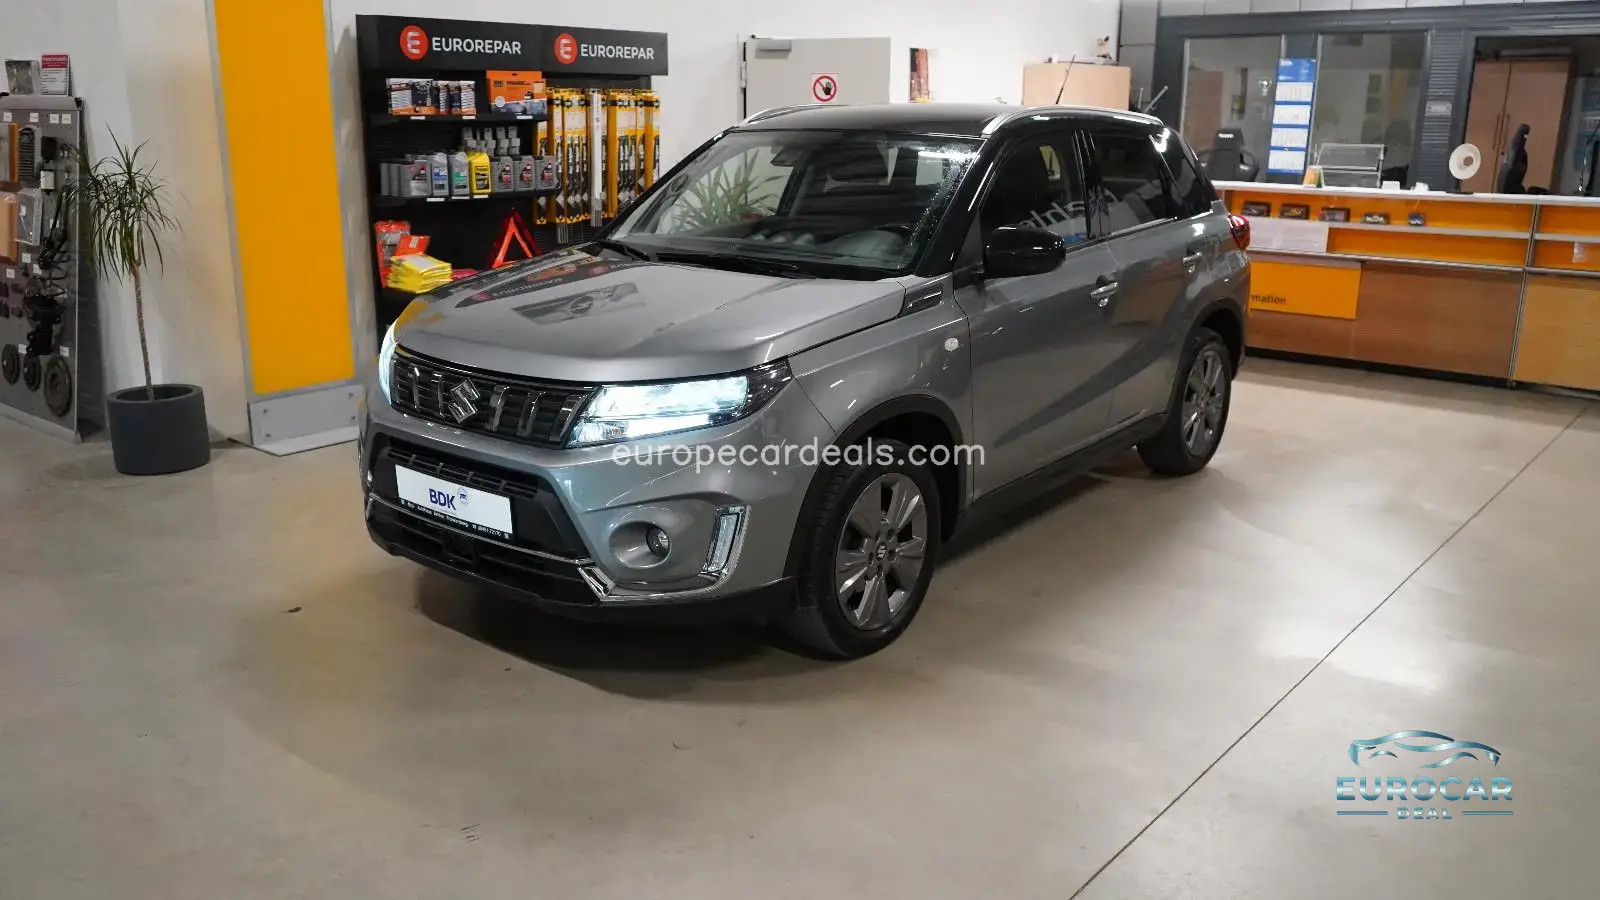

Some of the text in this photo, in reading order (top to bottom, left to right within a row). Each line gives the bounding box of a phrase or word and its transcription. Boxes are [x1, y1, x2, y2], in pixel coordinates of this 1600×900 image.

[431, 37, 522, 55] EUROREPAR
[580, 44, 655, 60] EUROREPAR
[429, 488, 456, 511] BDK
